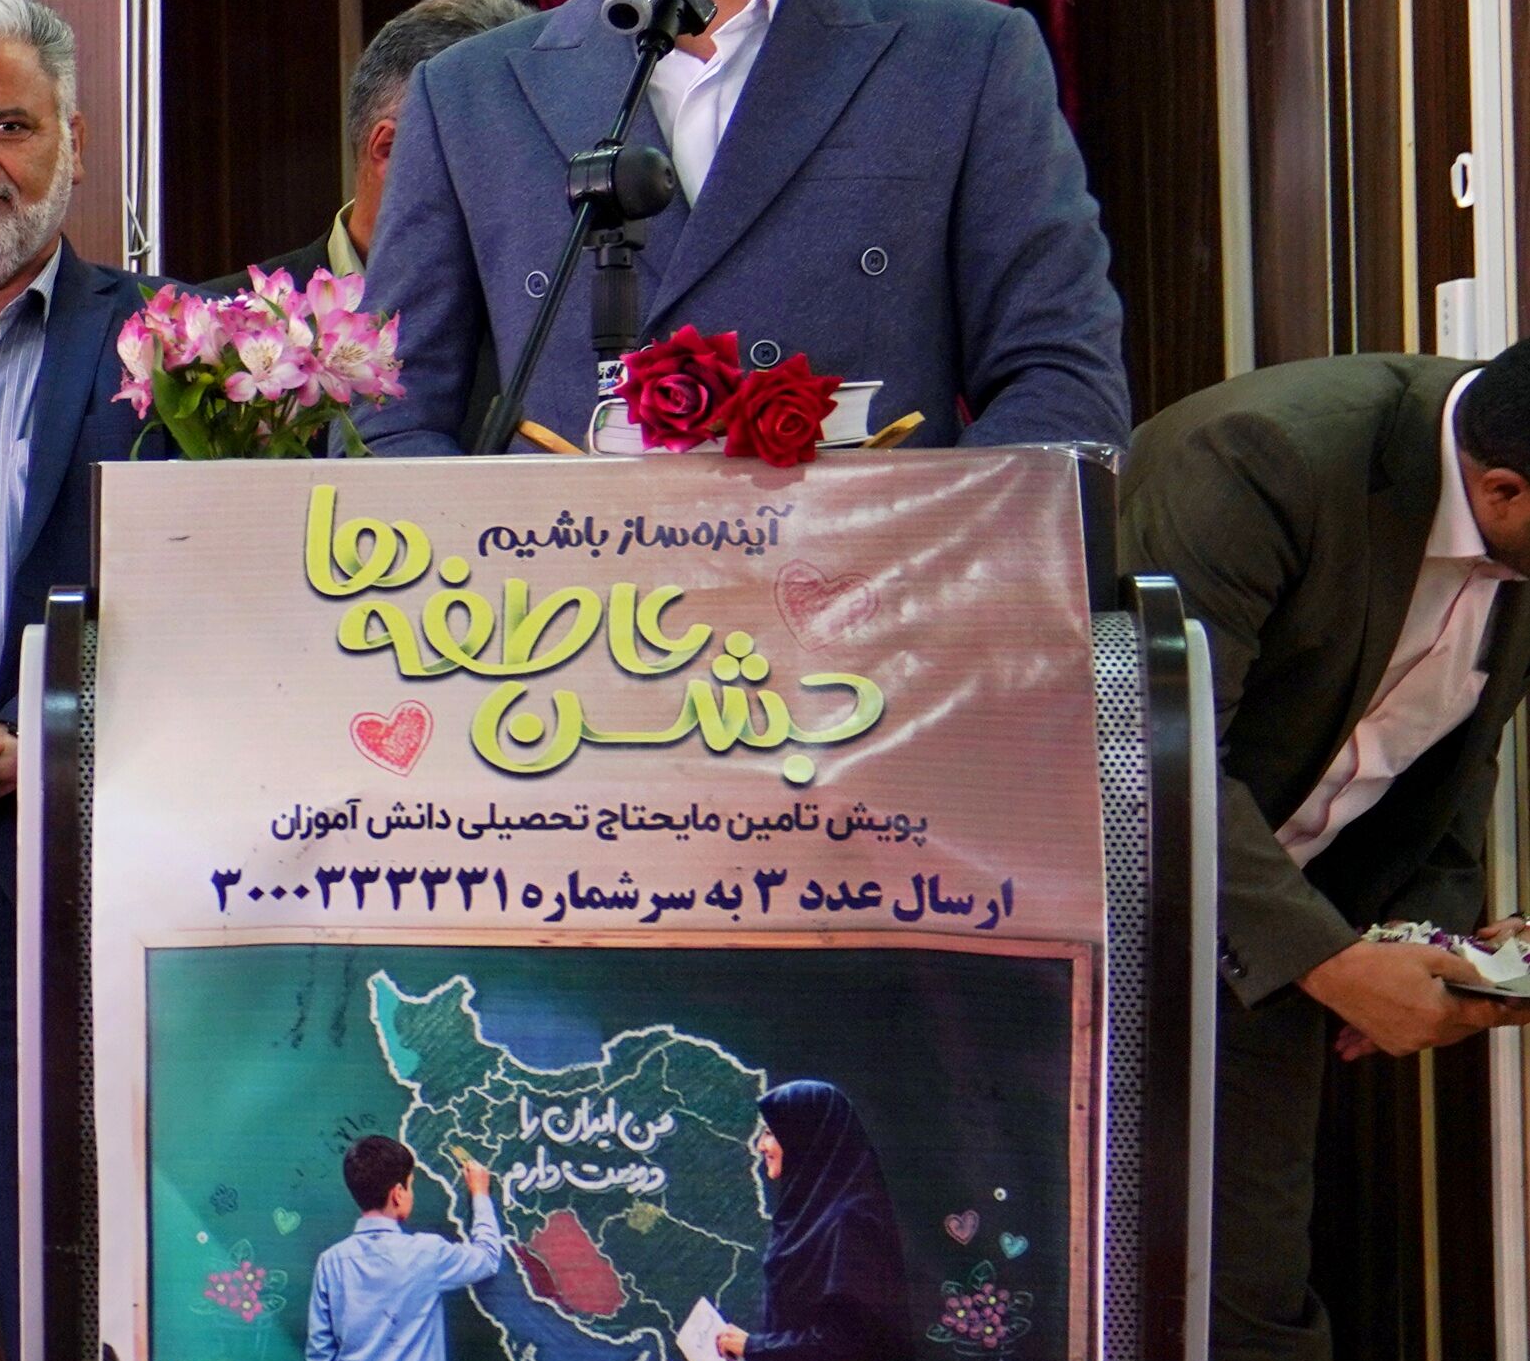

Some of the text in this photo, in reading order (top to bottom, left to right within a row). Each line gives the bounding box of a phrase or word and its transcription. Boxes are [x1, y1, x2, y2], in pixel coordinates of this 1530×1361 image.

[478, 510, 609, 558] باشیم
[471, 631, 885, 785] جشن
[271, 799, 928, 847] پویش تامین مایحتاج تحصیلی دانش آموزان
[704, 878, 743, 923] به
[753, 868, 788, 914] ۳
[799, 878, 883, 912] عدد
[893, 872, 1015, 930] ارسال
[519, 1095, 675, 1152] من ایران را
[503, 1144, 666, 1206] دوست دارم
